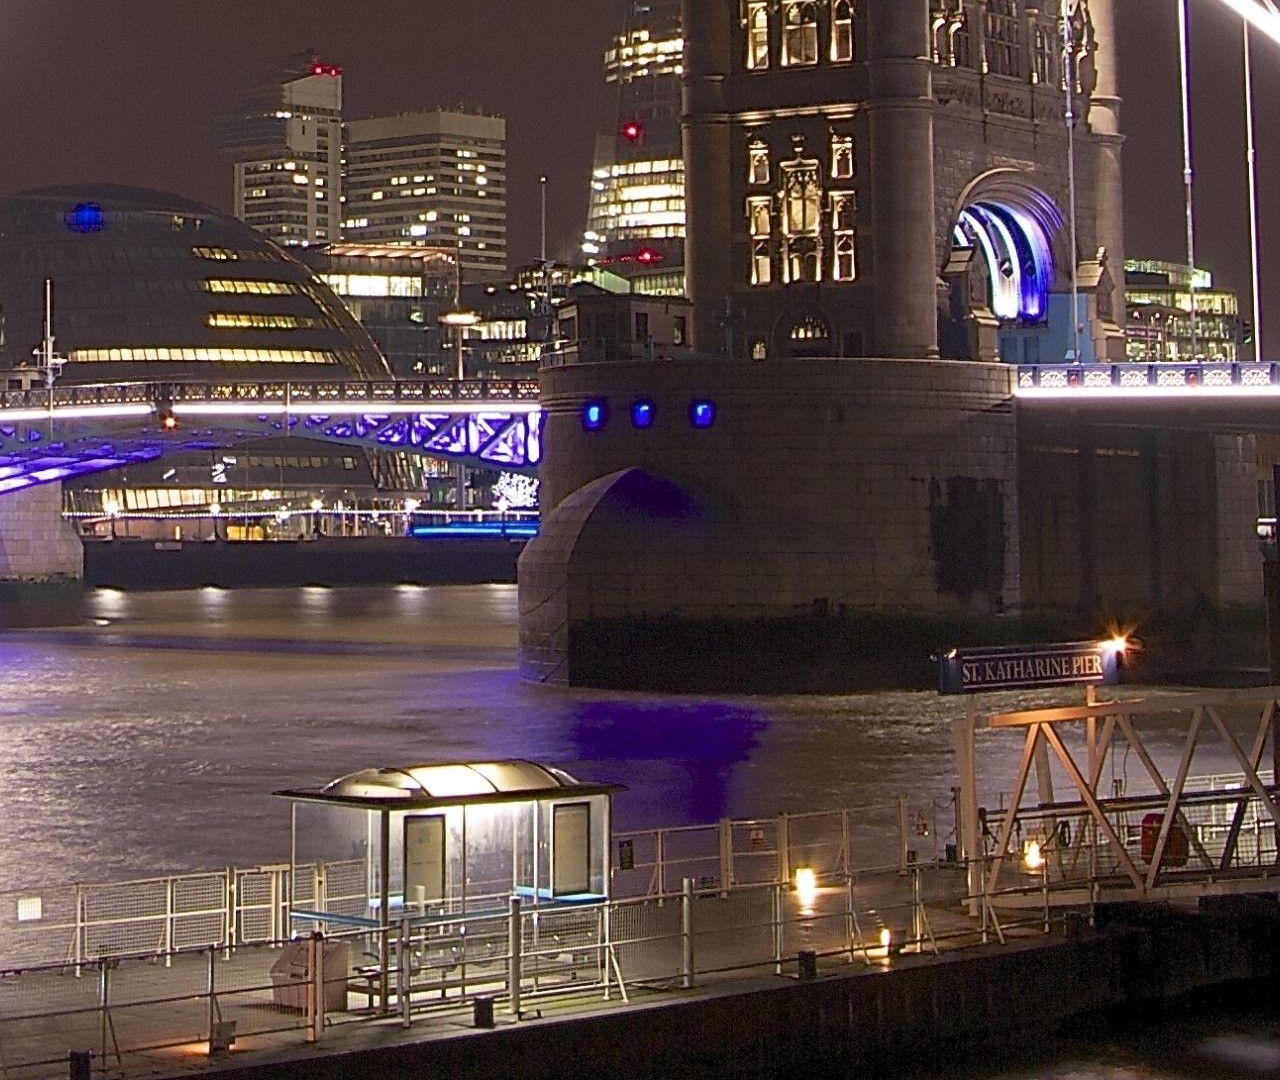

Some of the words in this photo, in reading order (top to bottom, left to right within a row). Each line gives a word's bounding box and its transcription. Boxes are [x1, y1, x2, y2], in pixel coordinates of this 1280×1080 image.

[962, 663, 980, 682] ST.
[986, 656, 1069, 680] KATHARINE
[1073, 655, 1102, 674] PIER
